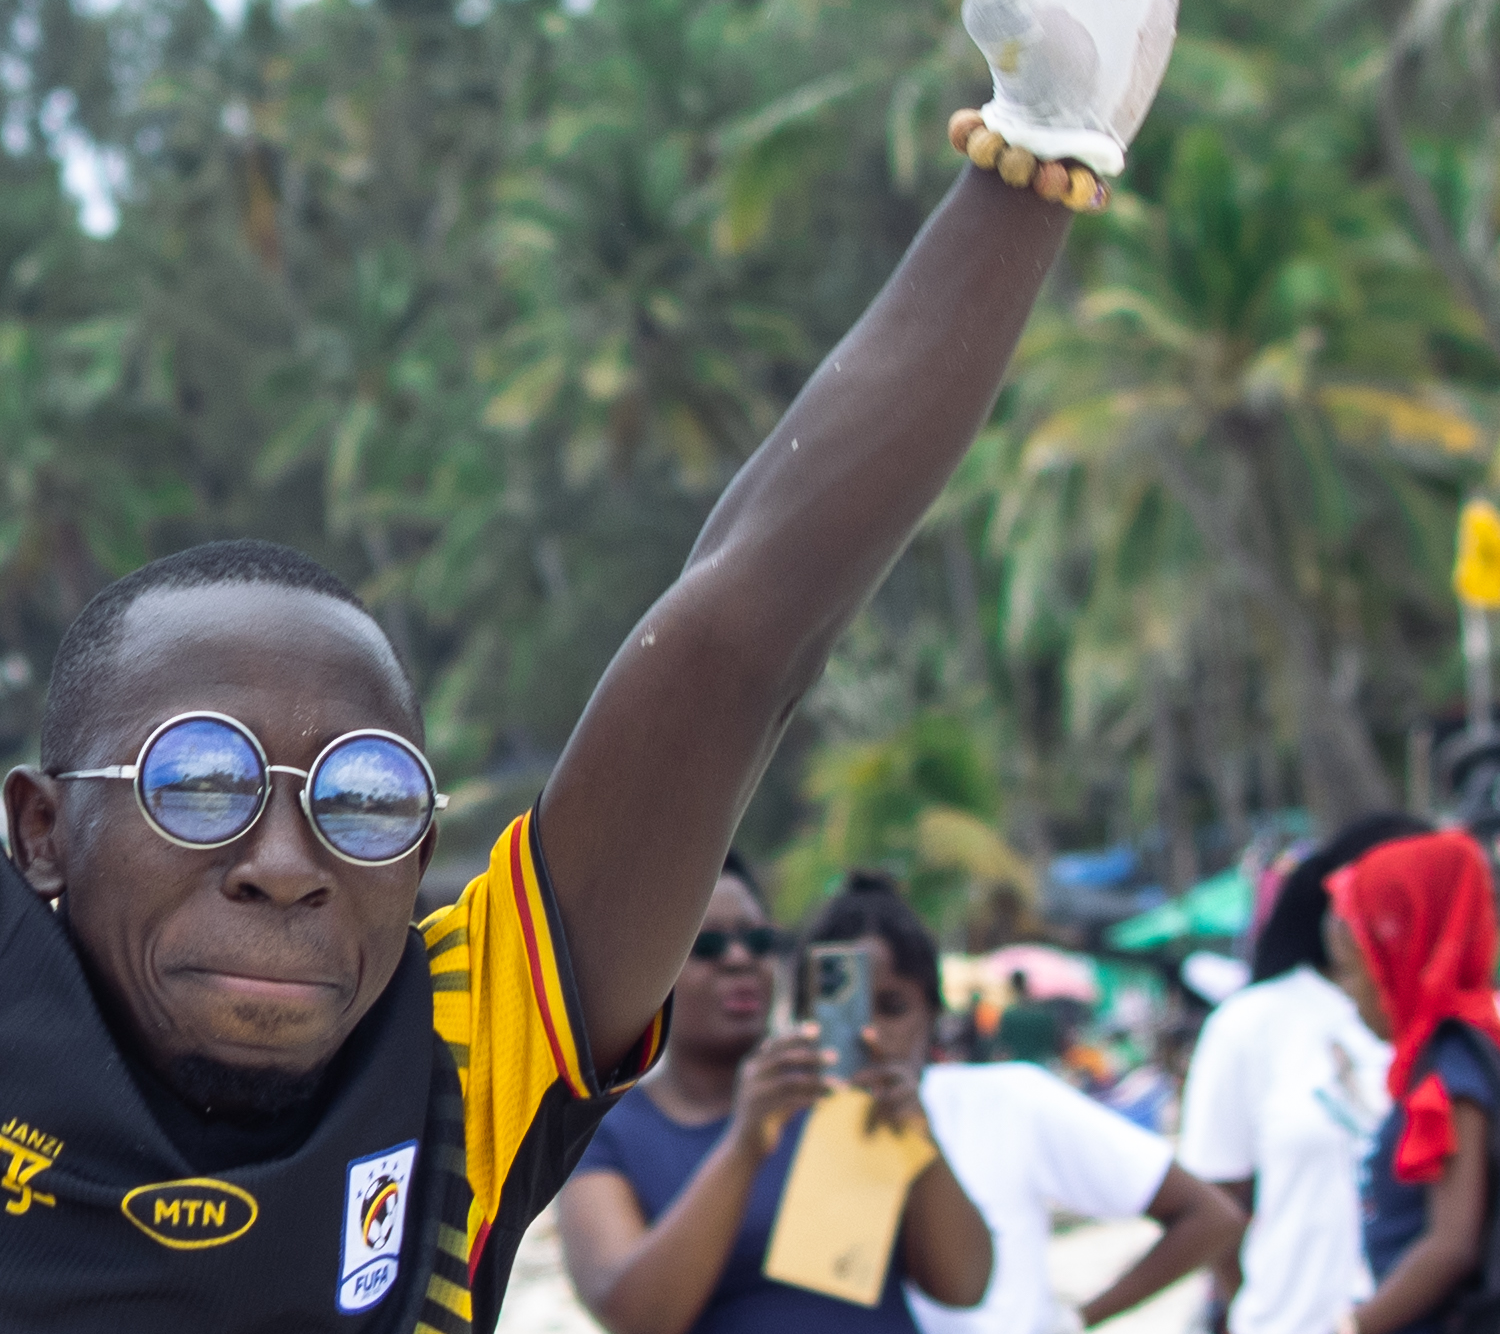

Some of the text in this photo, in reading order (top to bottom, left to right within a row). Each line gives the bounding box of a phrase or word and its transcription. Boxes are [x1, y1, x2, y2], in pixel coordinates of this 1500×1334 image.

[1, 1116, 64, 1160] JANZI
[154, 1199, 226, 1226] MTN
[353, 1264, 390, 1297] FUFA
